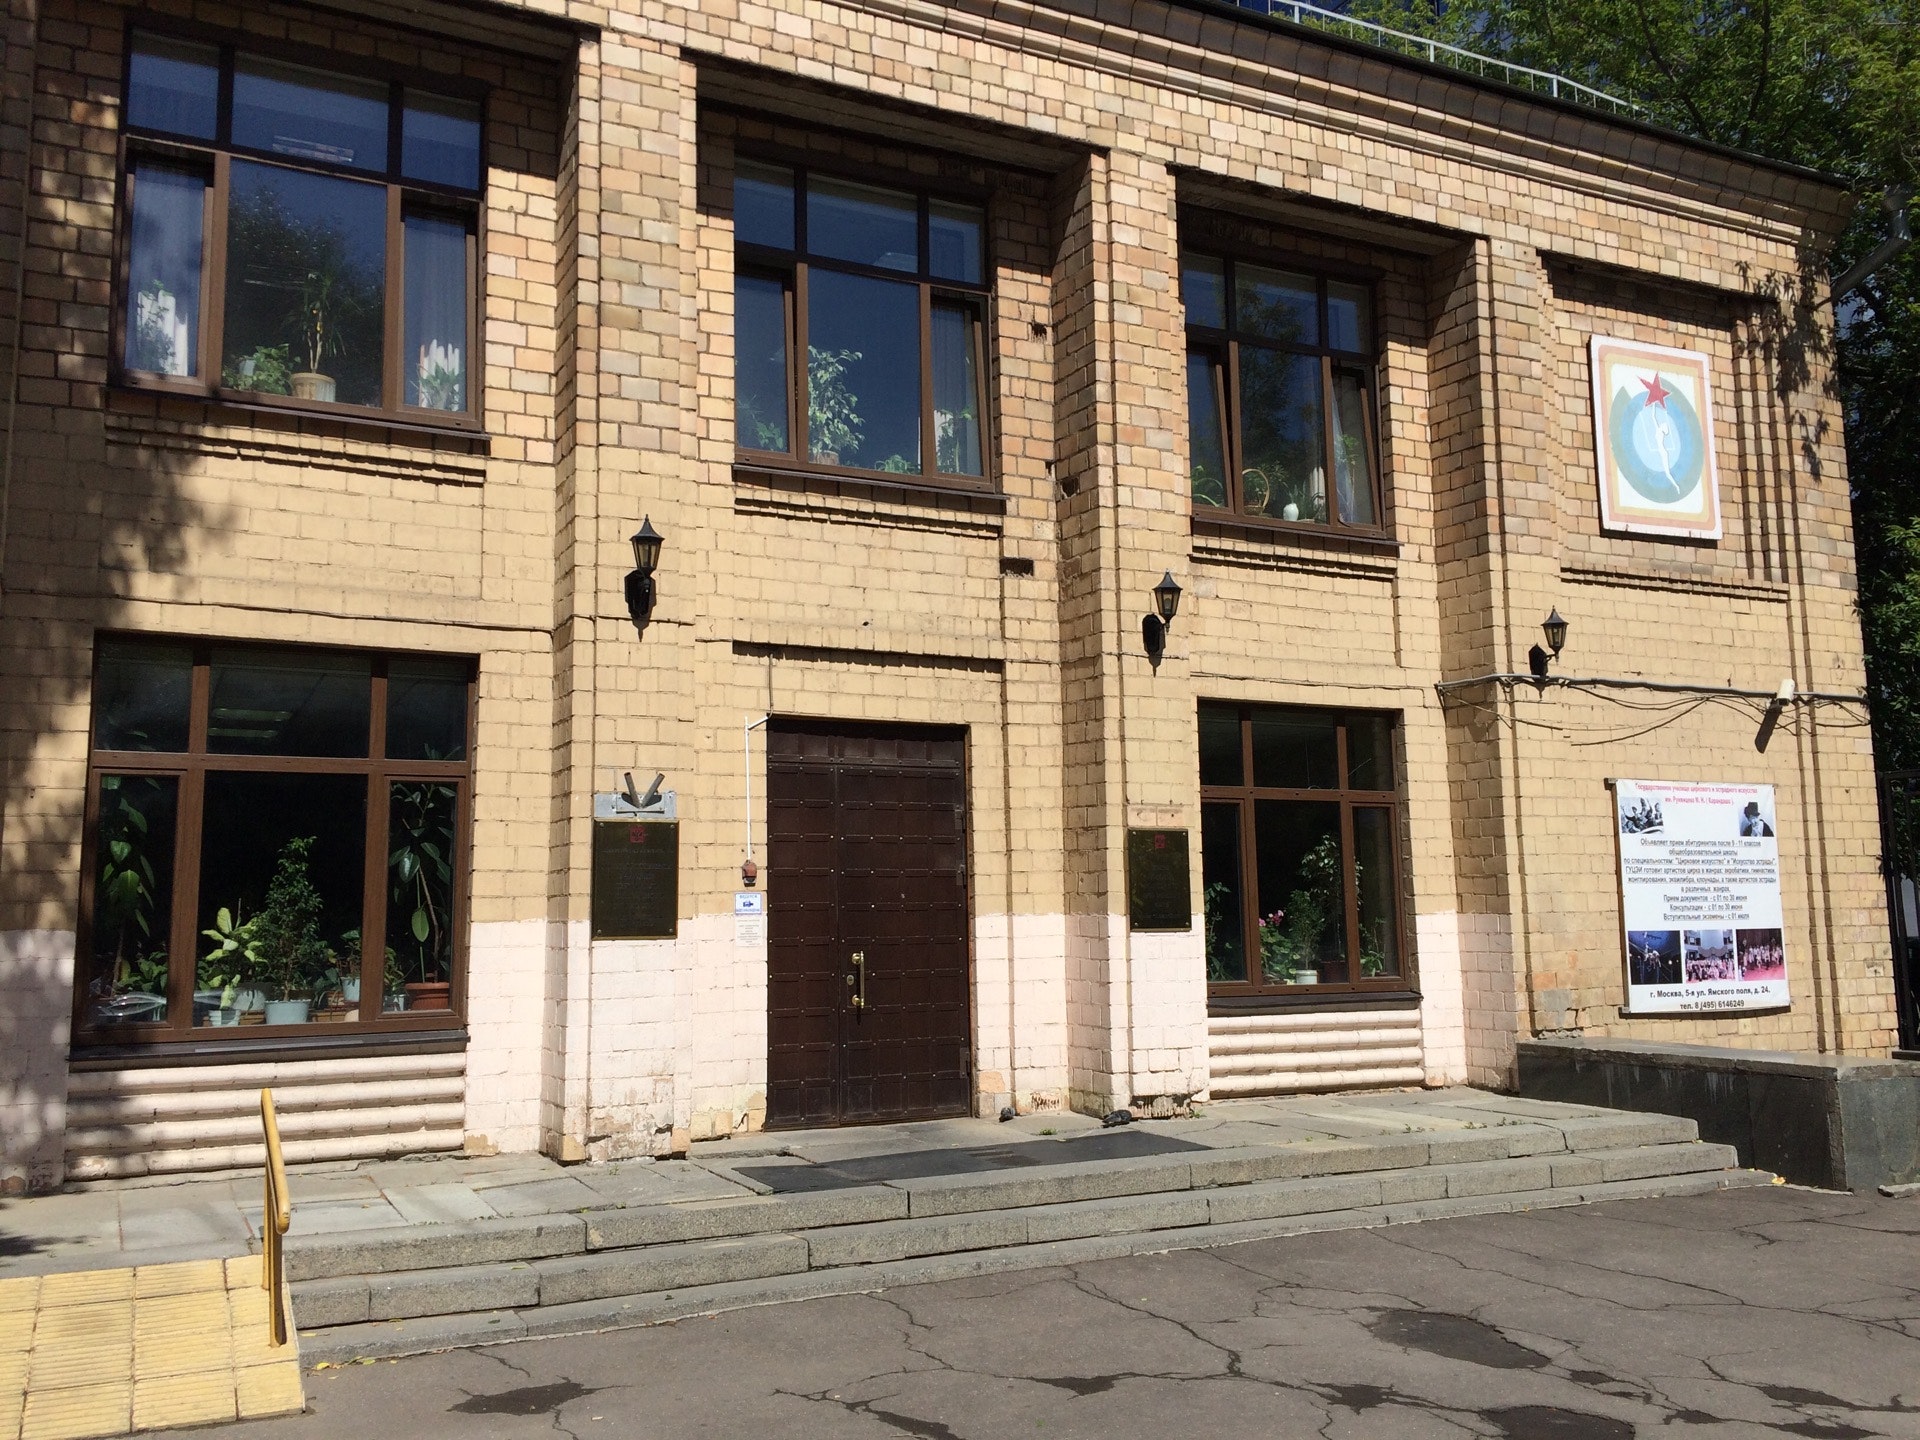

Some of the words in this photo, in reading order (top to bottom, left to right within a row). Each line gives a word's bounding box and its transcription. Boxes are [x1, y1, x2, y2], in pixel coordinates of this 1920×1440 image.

[1657, 990, 1684, 998] Москва,
[1696, 990, 1706, 998] ул.
[1708, 988, 1734, 996] Ямского
[1700, 1001, 1716, 1010] (495)
[1718, 1000, 1744, 1008] 6146249
